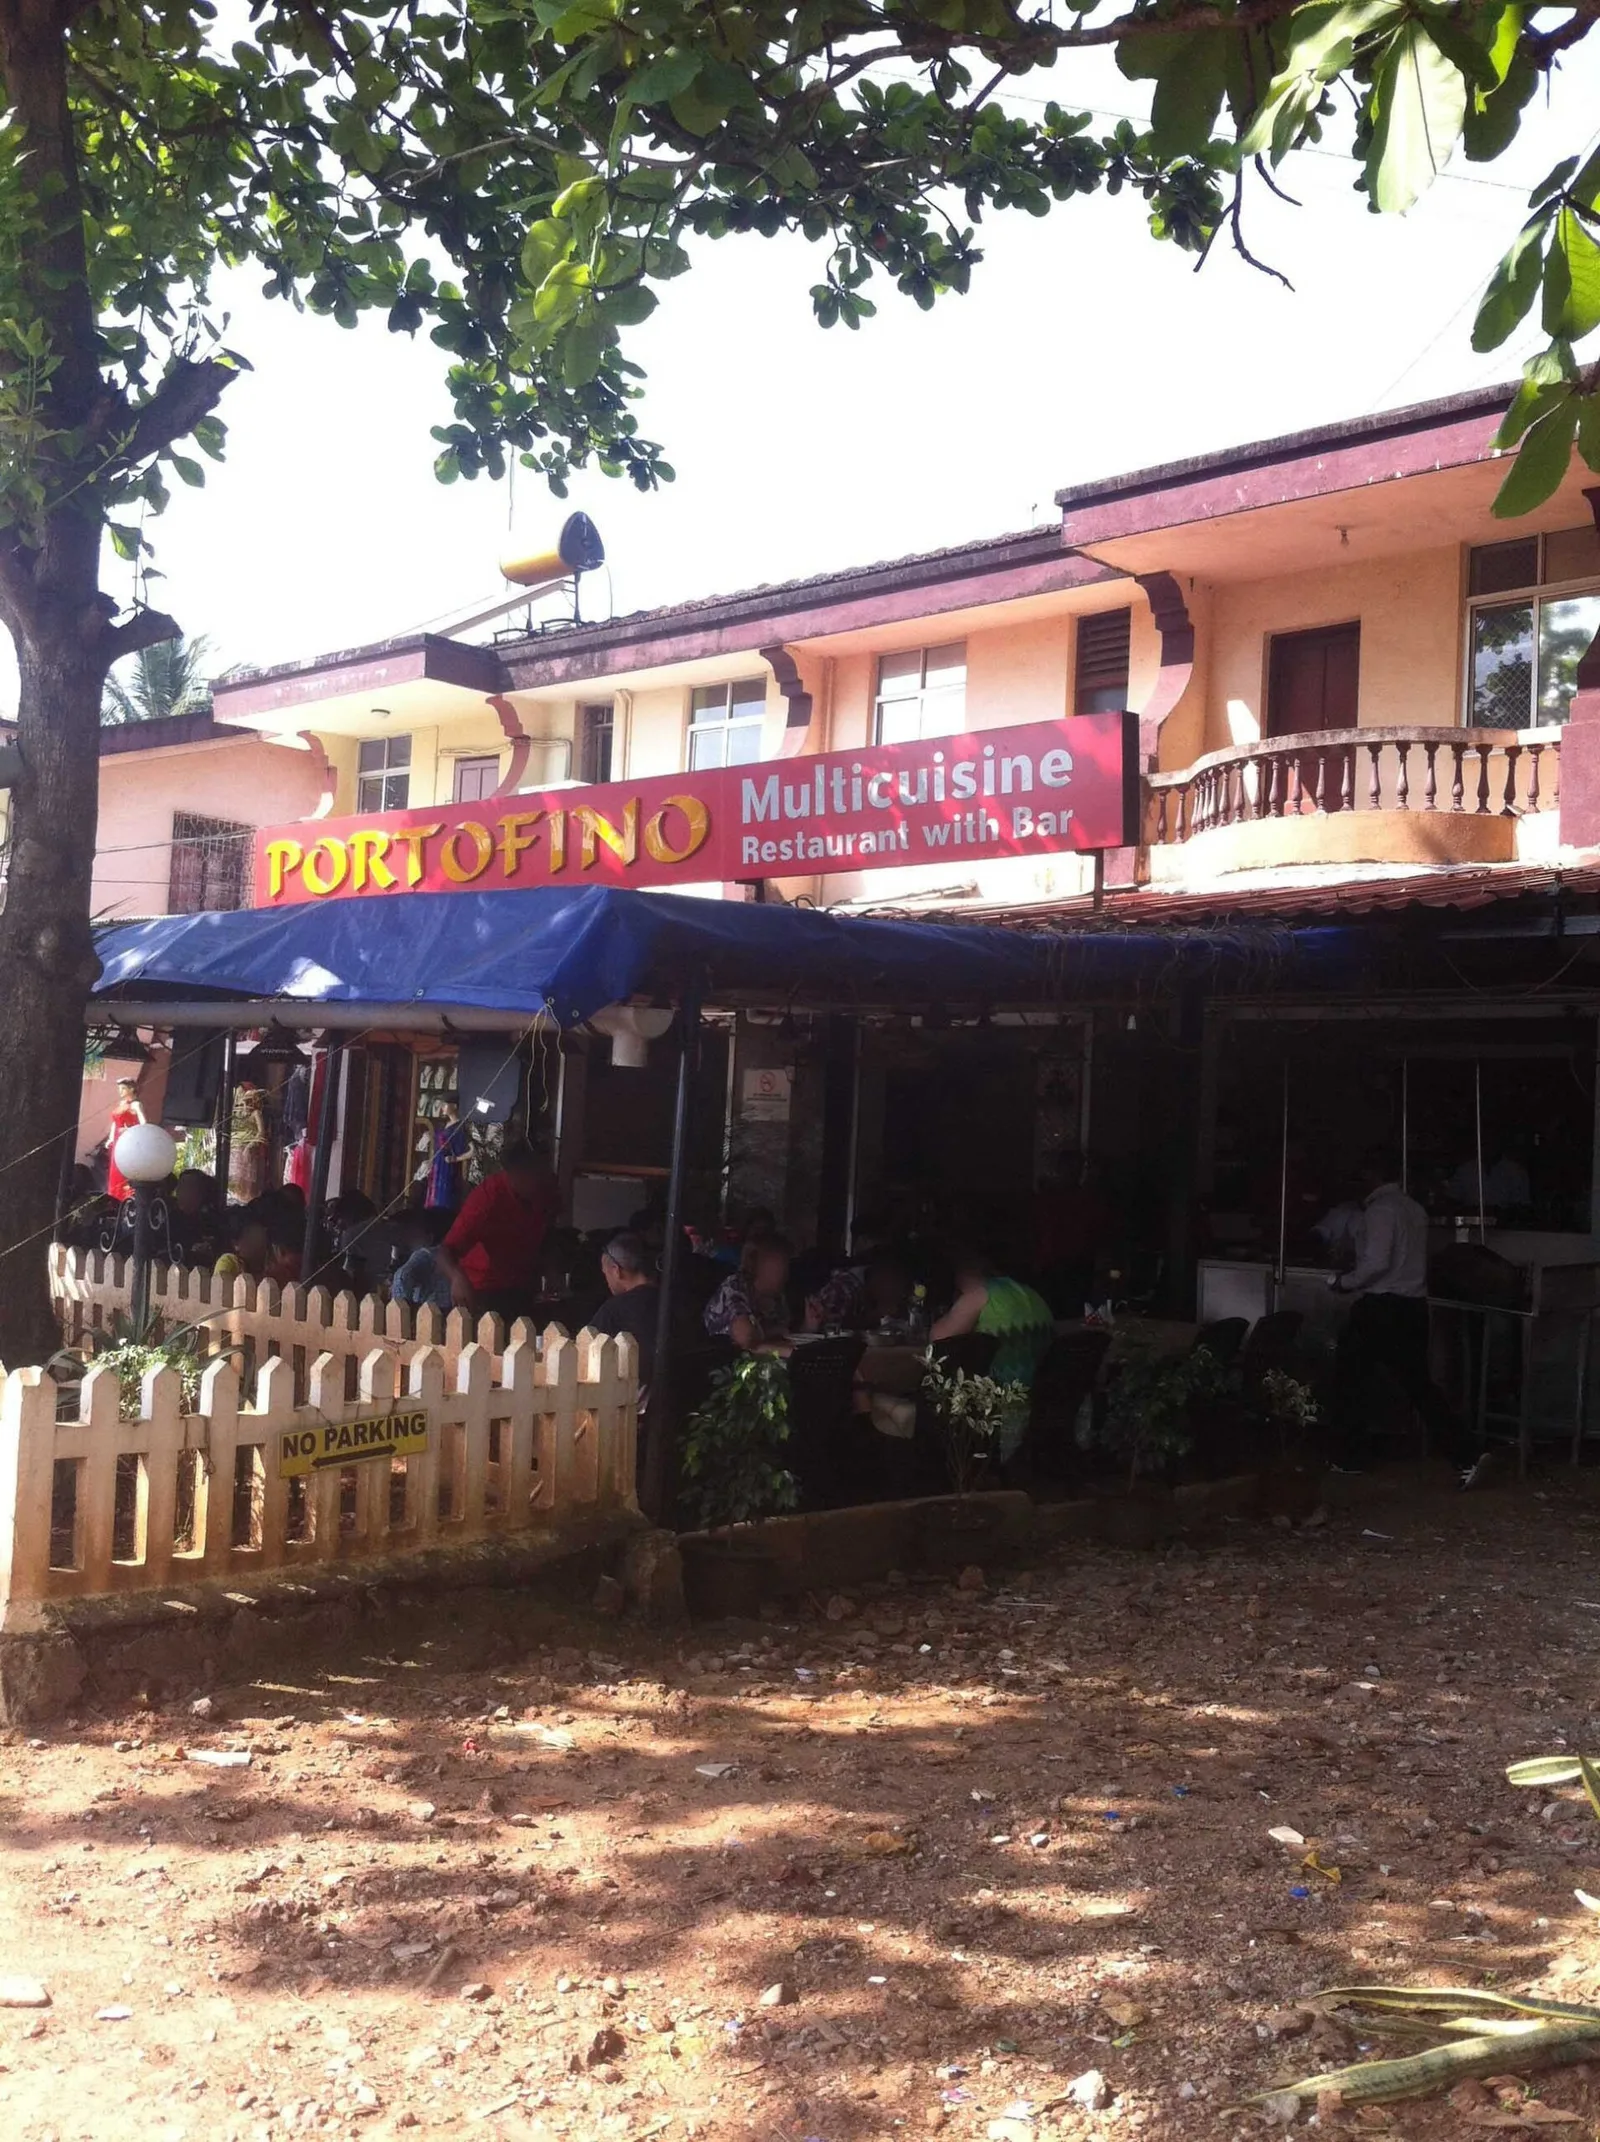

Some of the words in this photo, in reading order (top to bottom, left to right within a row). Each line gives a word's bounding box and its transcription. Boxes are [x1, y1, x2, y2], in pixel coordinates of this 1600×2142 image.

[741, 744, 1074, 824] Multicuisine
[265, 794, 710, 899] PORTOFINO
[742, 820, 909, 865] Restaurant
[921, 808, 999, 847] with
[1012, 806, 1074, 839] Bar
[283, 1432, 316, 1459] NO
[324, 1413, 426, 1451] PARKING
